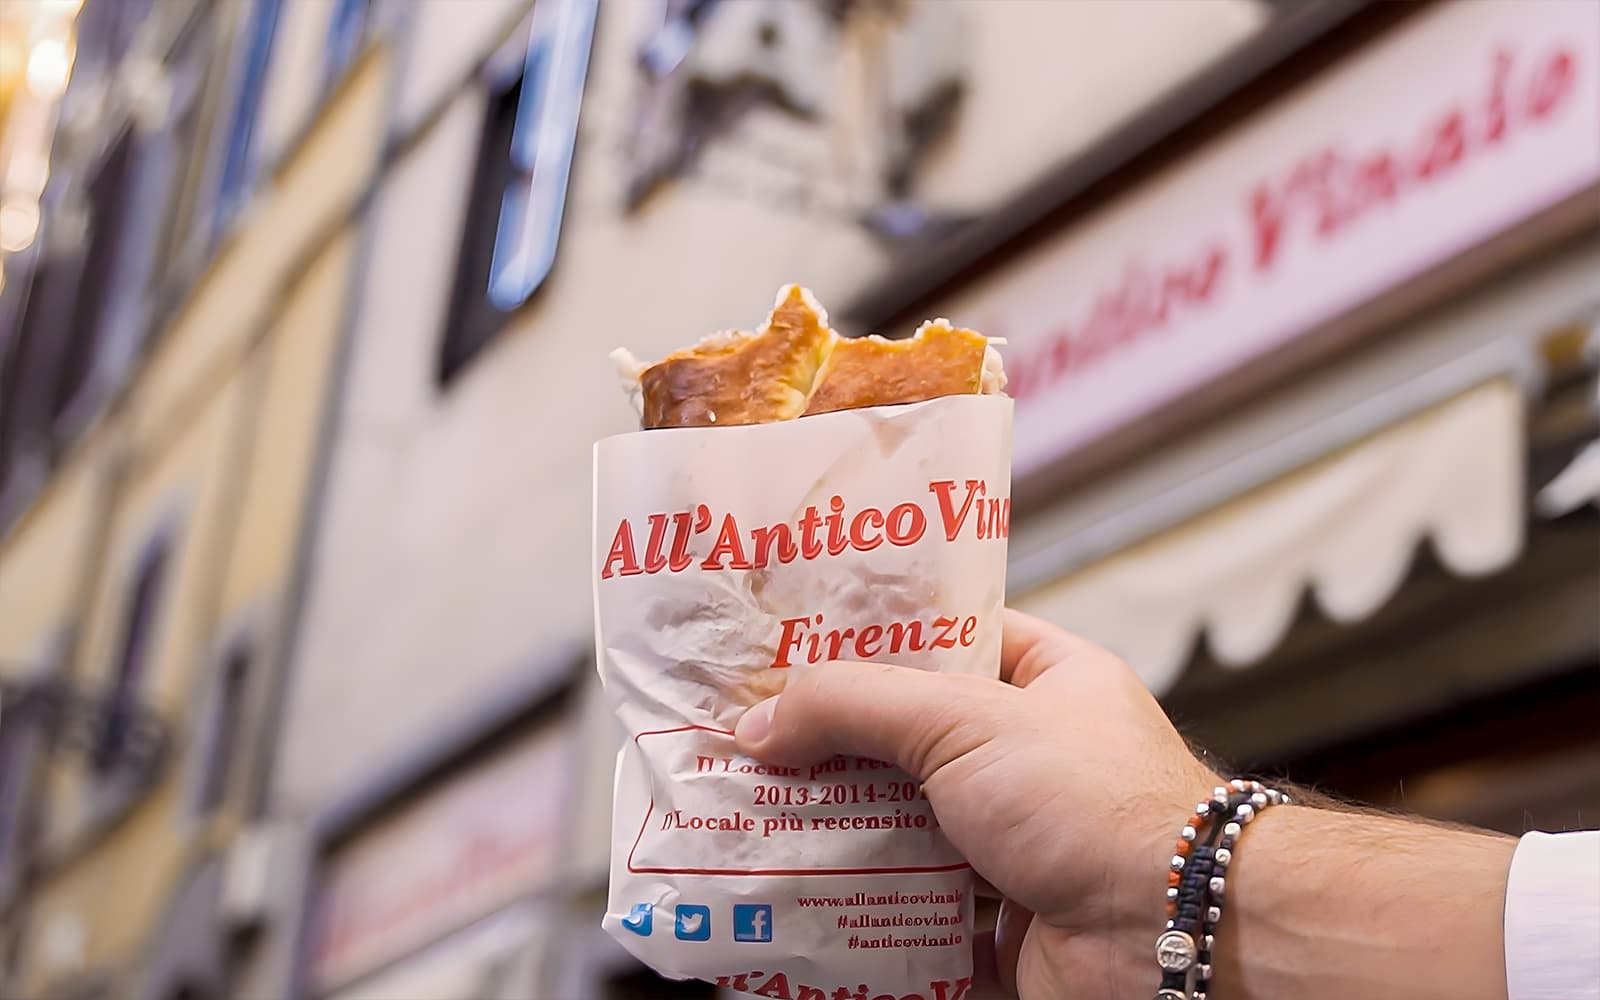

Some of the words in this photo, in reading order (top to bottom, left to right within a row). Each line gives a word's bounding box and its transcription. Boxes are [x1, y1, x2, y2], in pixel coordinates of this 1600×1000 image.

[770, 614, 977, 669] Firenze
[674, 810, 755, 832] Locale
[763, 811, 804, 837] più
[812, 809, 928, 831] recensito
